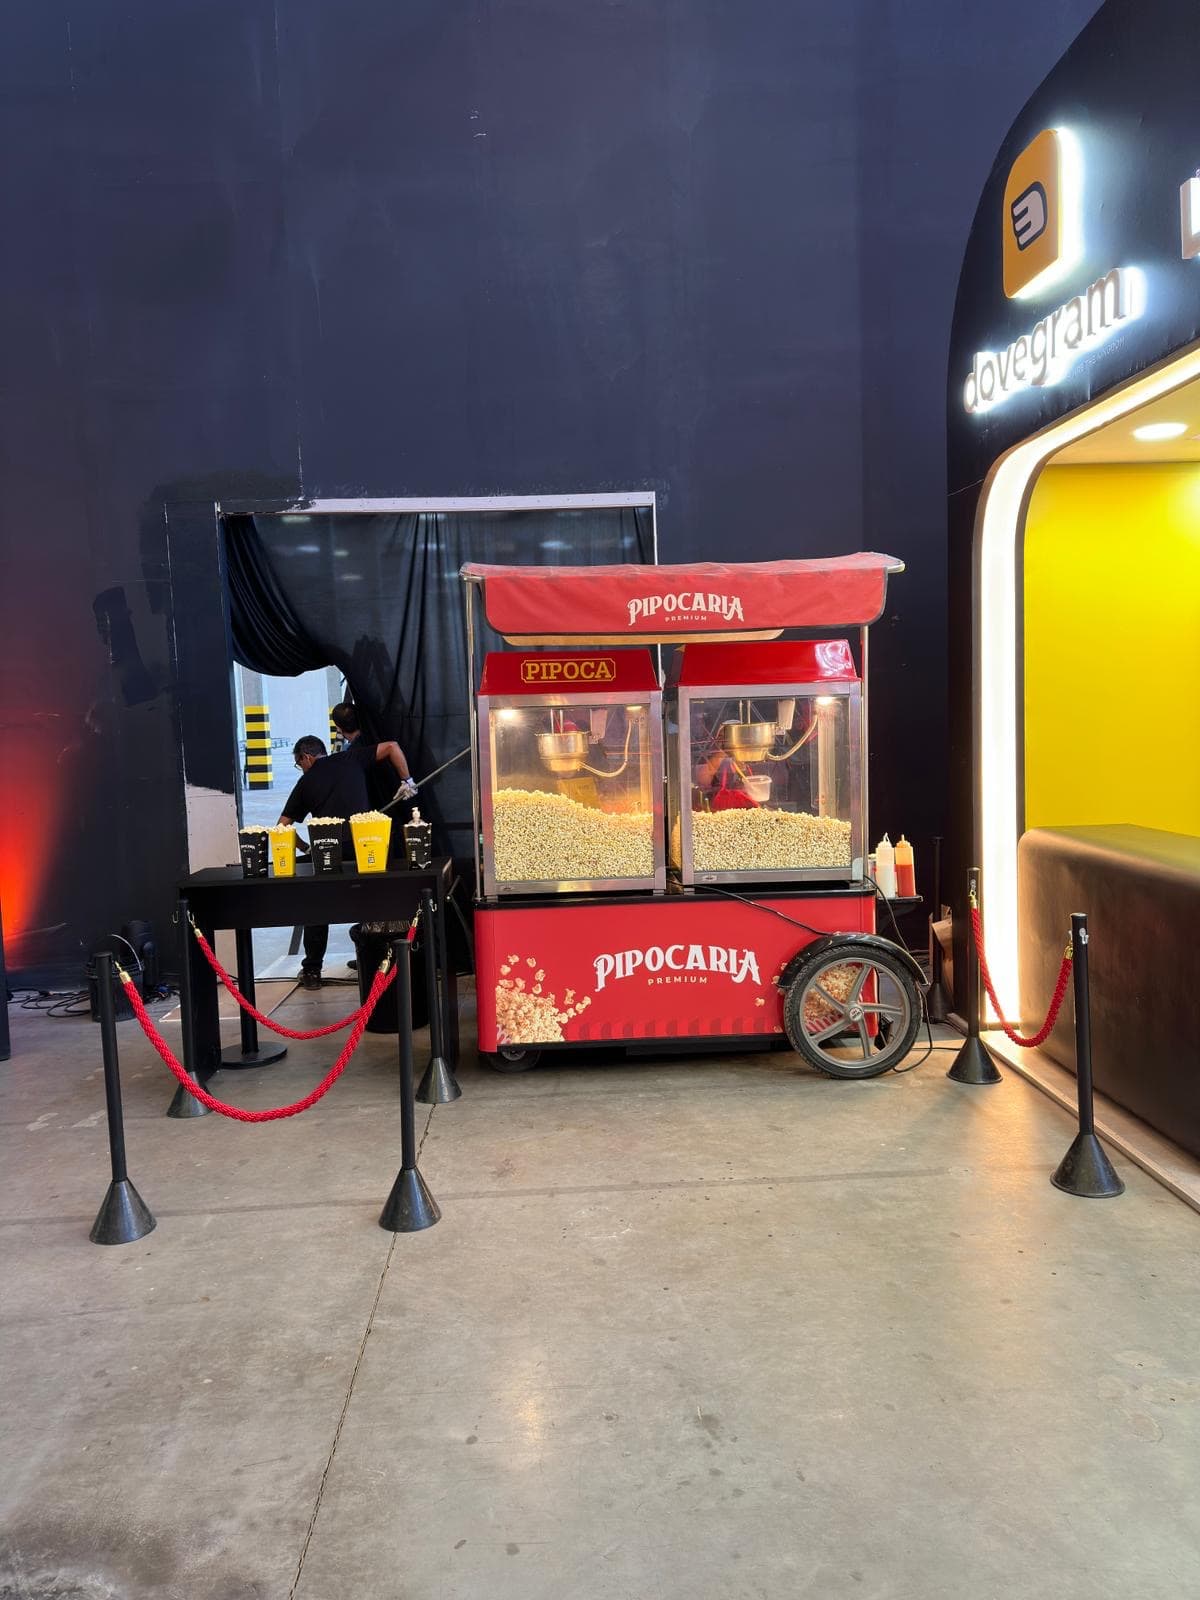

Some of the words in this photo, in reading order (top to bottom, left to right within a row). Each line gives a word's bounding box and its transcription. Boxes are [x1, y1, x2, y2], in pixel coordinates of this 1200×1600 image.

[963, 266, 1144, 414] dovegram
[627, 592, 745, 626] PIPOCARIA
[664, 614, 708, 623] PREMIUM
[525, 661, 613, 680] PIPOCA
[593, 944, 762, 992] PIPOCARIA
[647, 976, 708, 986] PREMIUM
